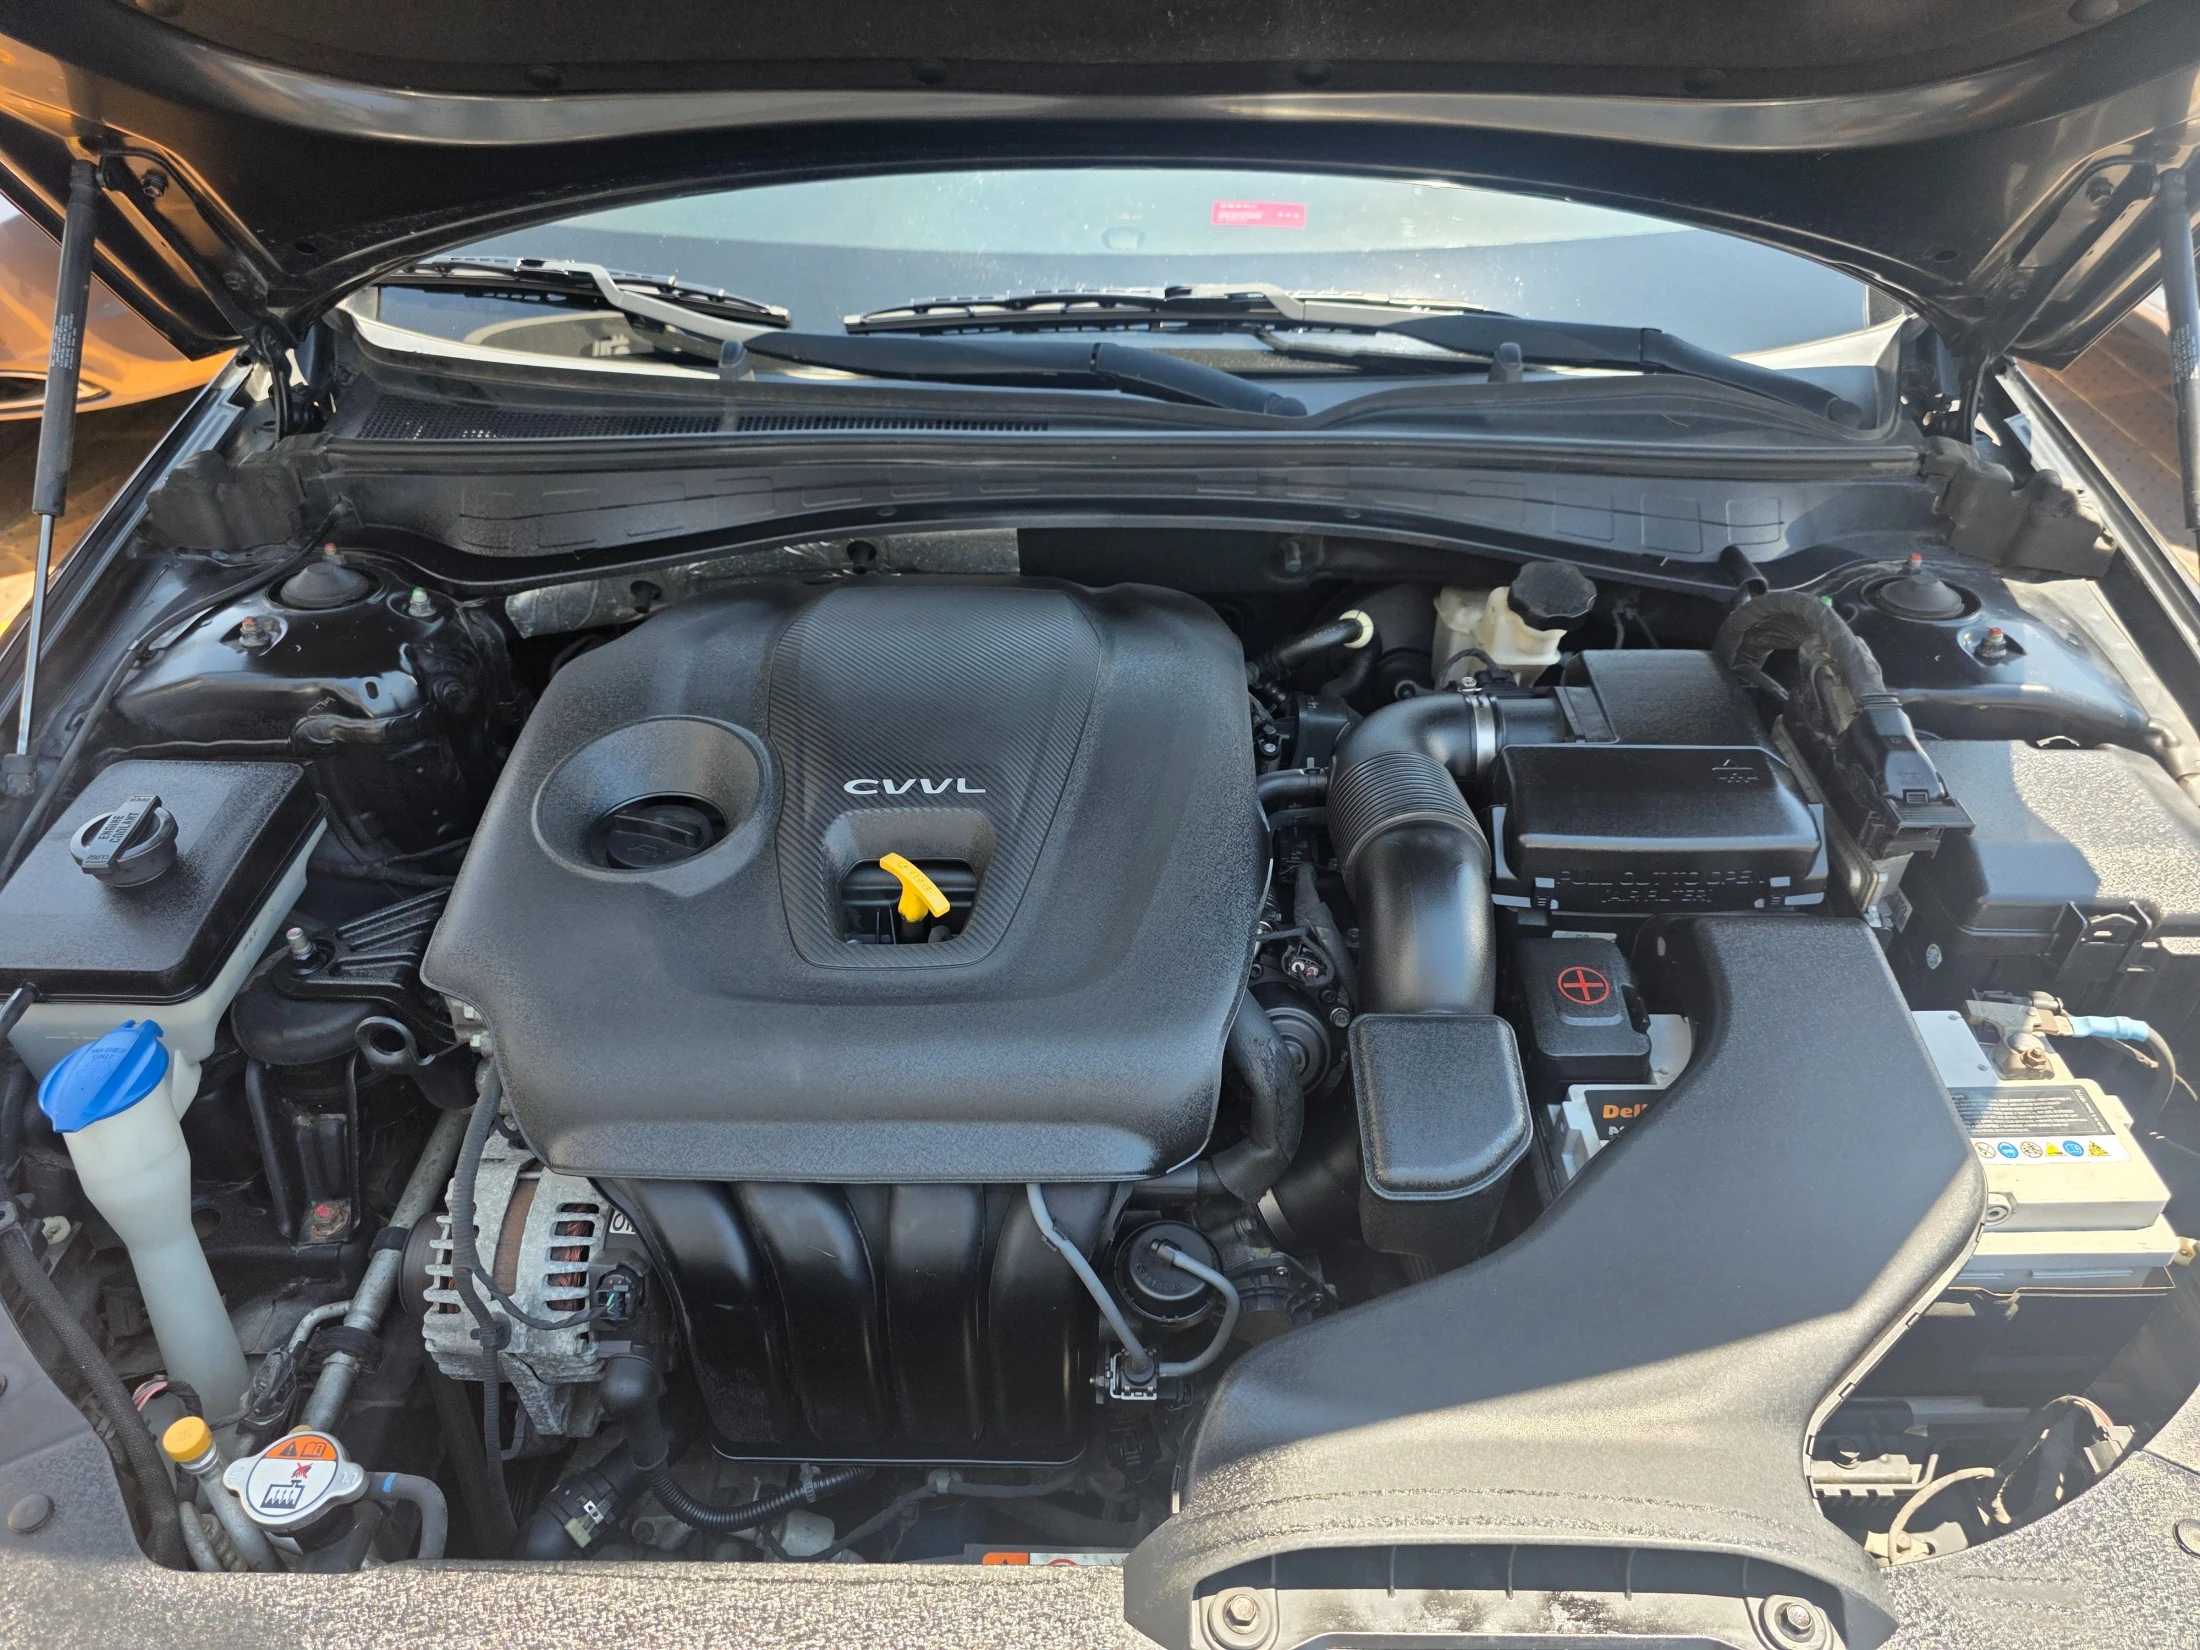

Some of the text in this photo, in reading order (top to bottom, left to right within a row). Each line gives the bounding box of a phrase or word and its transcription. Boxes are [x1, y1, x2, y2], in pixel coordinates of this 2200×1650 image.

[843, 777, 987, 795] CVVL
[98, 815, 125, 840] ENGINE
[109, 812, 140, 843] COOLANT
